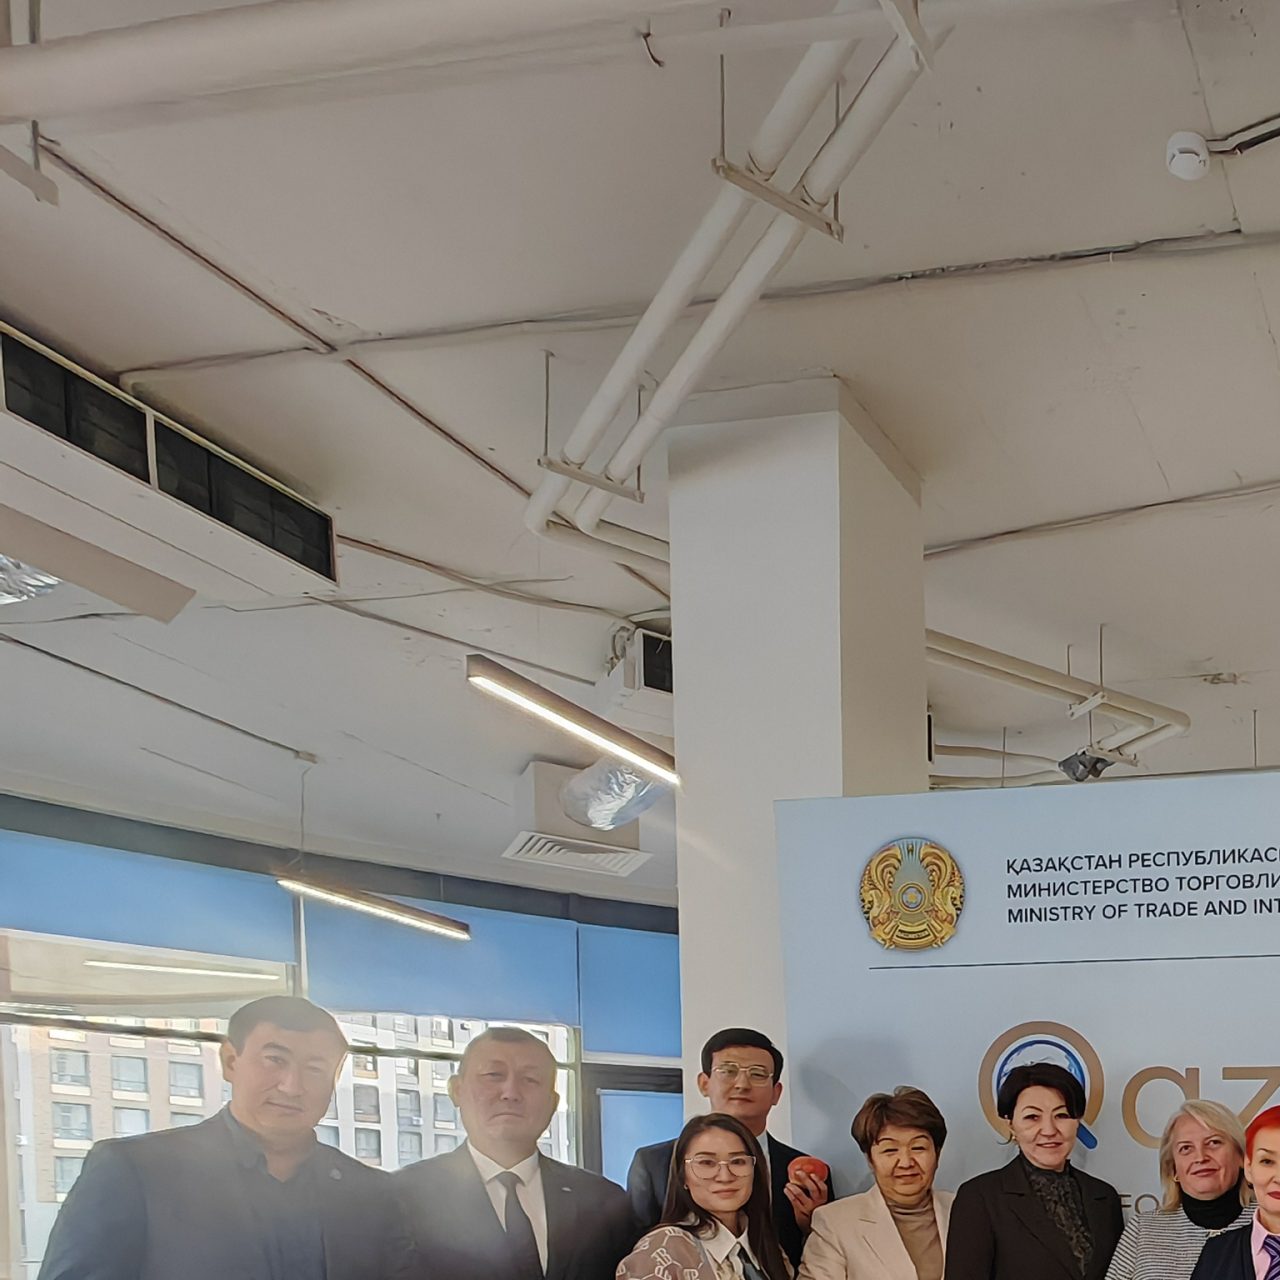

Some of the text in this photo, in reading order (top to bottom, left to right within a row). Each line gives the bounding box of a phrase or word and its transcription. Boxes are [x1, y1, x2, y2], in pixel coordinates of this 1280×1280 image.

[1007, 854, 1122, 876] ҚАЗАҚСТАН
[1007, 878, 1170, 899] МИНИСТЕРСТВО
[1007, 904, 1096, 924] MINISTRY
[1102, 904, 1129, 920] OF
[1135, 902, 1199, 919] TRADE
[1204, 899, 1248, 916] AND
